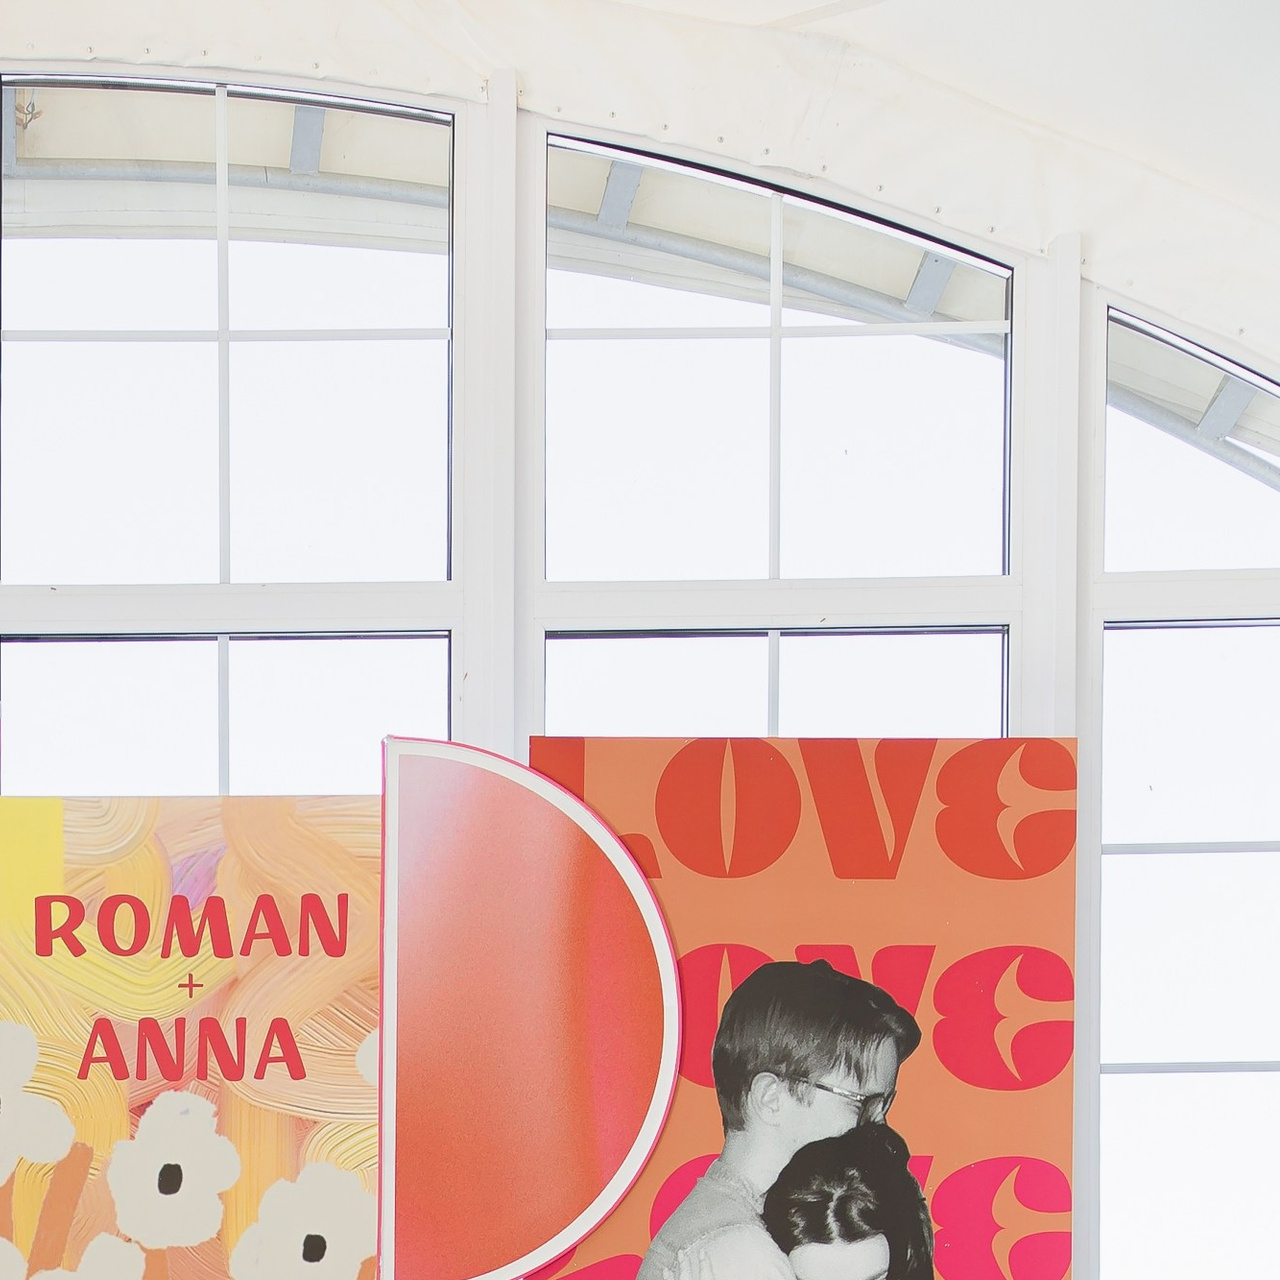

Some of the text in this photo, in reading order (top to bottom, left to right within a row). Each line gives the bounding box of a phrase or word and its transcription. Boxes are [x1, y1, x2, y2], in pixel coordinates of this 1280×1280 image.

[34, 893, 349, 959] ROMAN
[178, 973, 204, 999] +
[77, 1017, 306, 1082] ANNA
